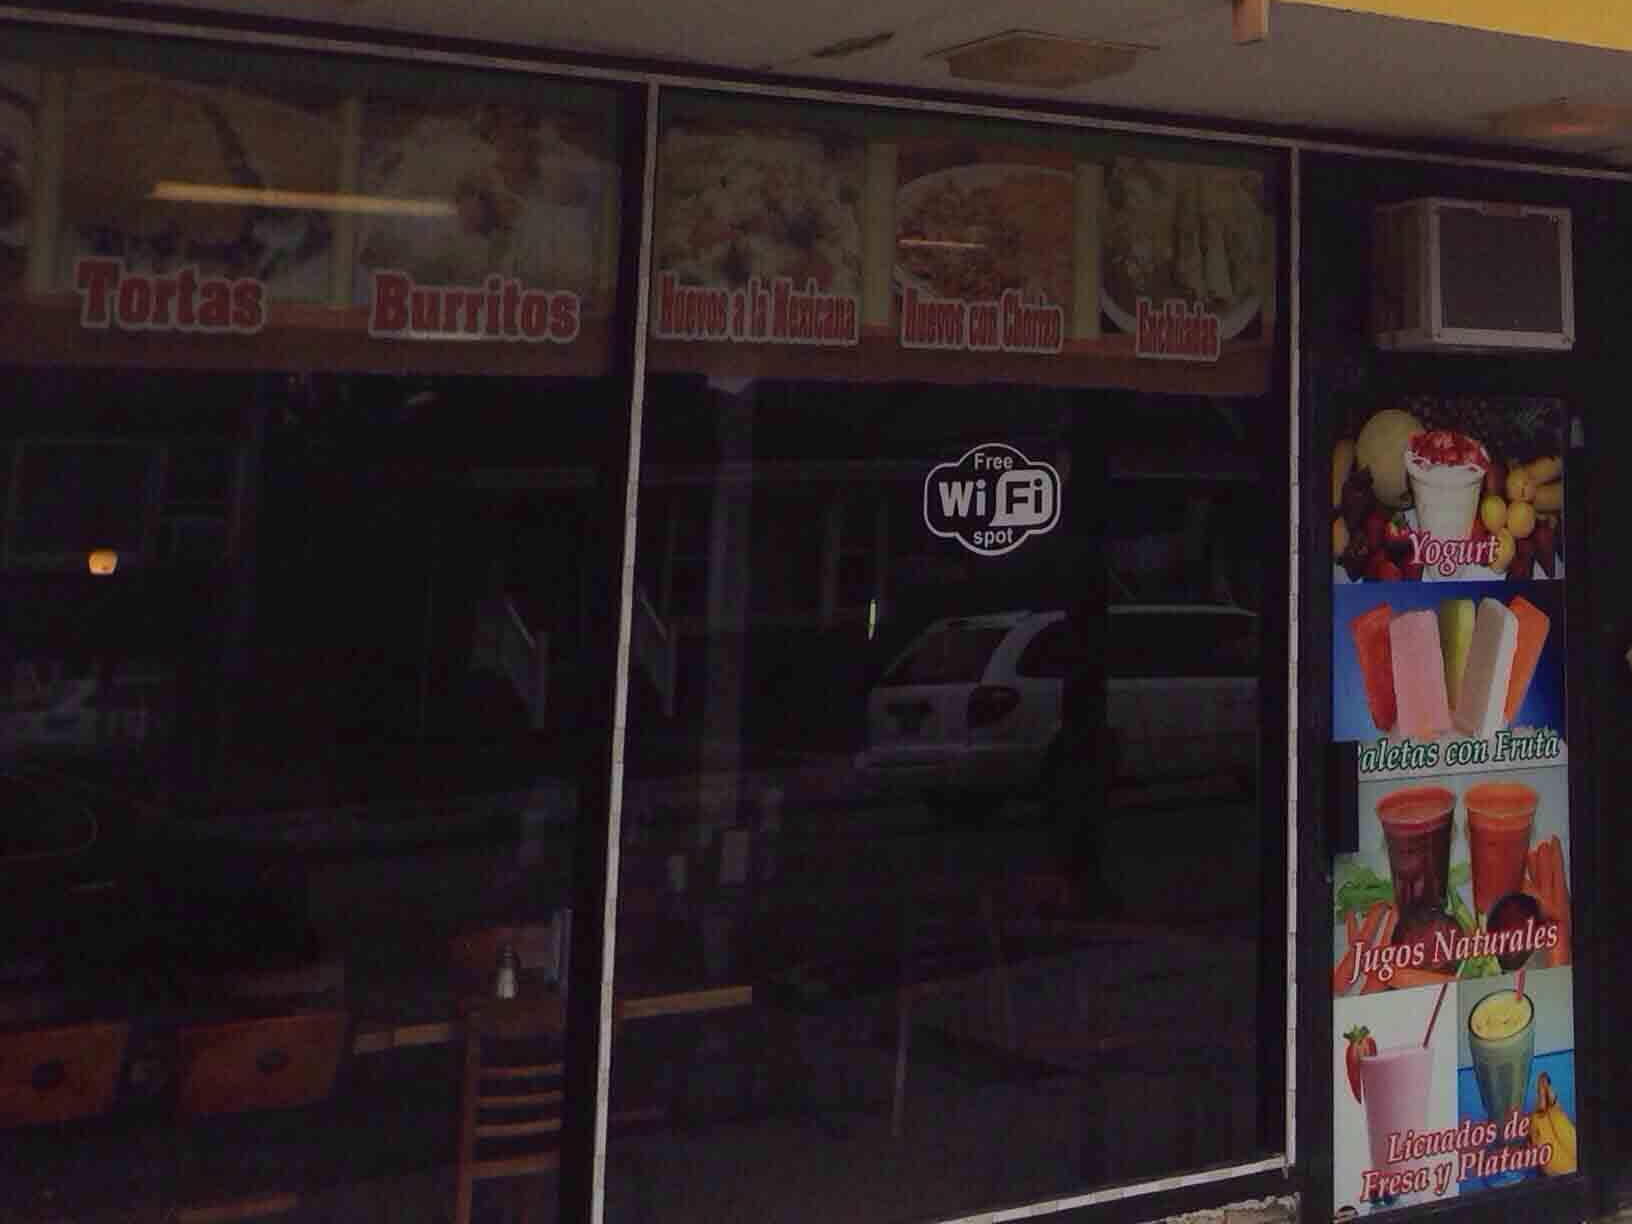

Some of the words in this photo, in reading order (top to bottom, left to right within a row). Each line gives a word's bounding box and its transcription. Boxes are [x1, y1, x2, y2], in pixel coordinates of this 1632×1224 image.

[76, 260, 266, 334] Tortas
[368, 270, 580, 343] Burritos
[656, 272, 728, 343] Huevos
[769, 278, 857, 346] Mexicana
[974, 453, 1013, 470] Free
[973, 528, 1013, 547] spot
[1408, 531, 1501, 575] Yogurt
[1357, 736, 1438, 773] aletas
[1445, 736, 1490, 767] con
[1493, 731, 1561, 763] Fruta
[1350, 940, 1424, 983] Jugos
[1432, 919, 1558, 967] Naturales
[1387, 1121, 1497, 1165] Licuados
[1503, 1110, 1530, 1140] de
[1360, 1165, 1429, 1203] Fresa
[1434, 1164, 1452, 1196] y
[1457, 1141, 1553, 1183] Platano
